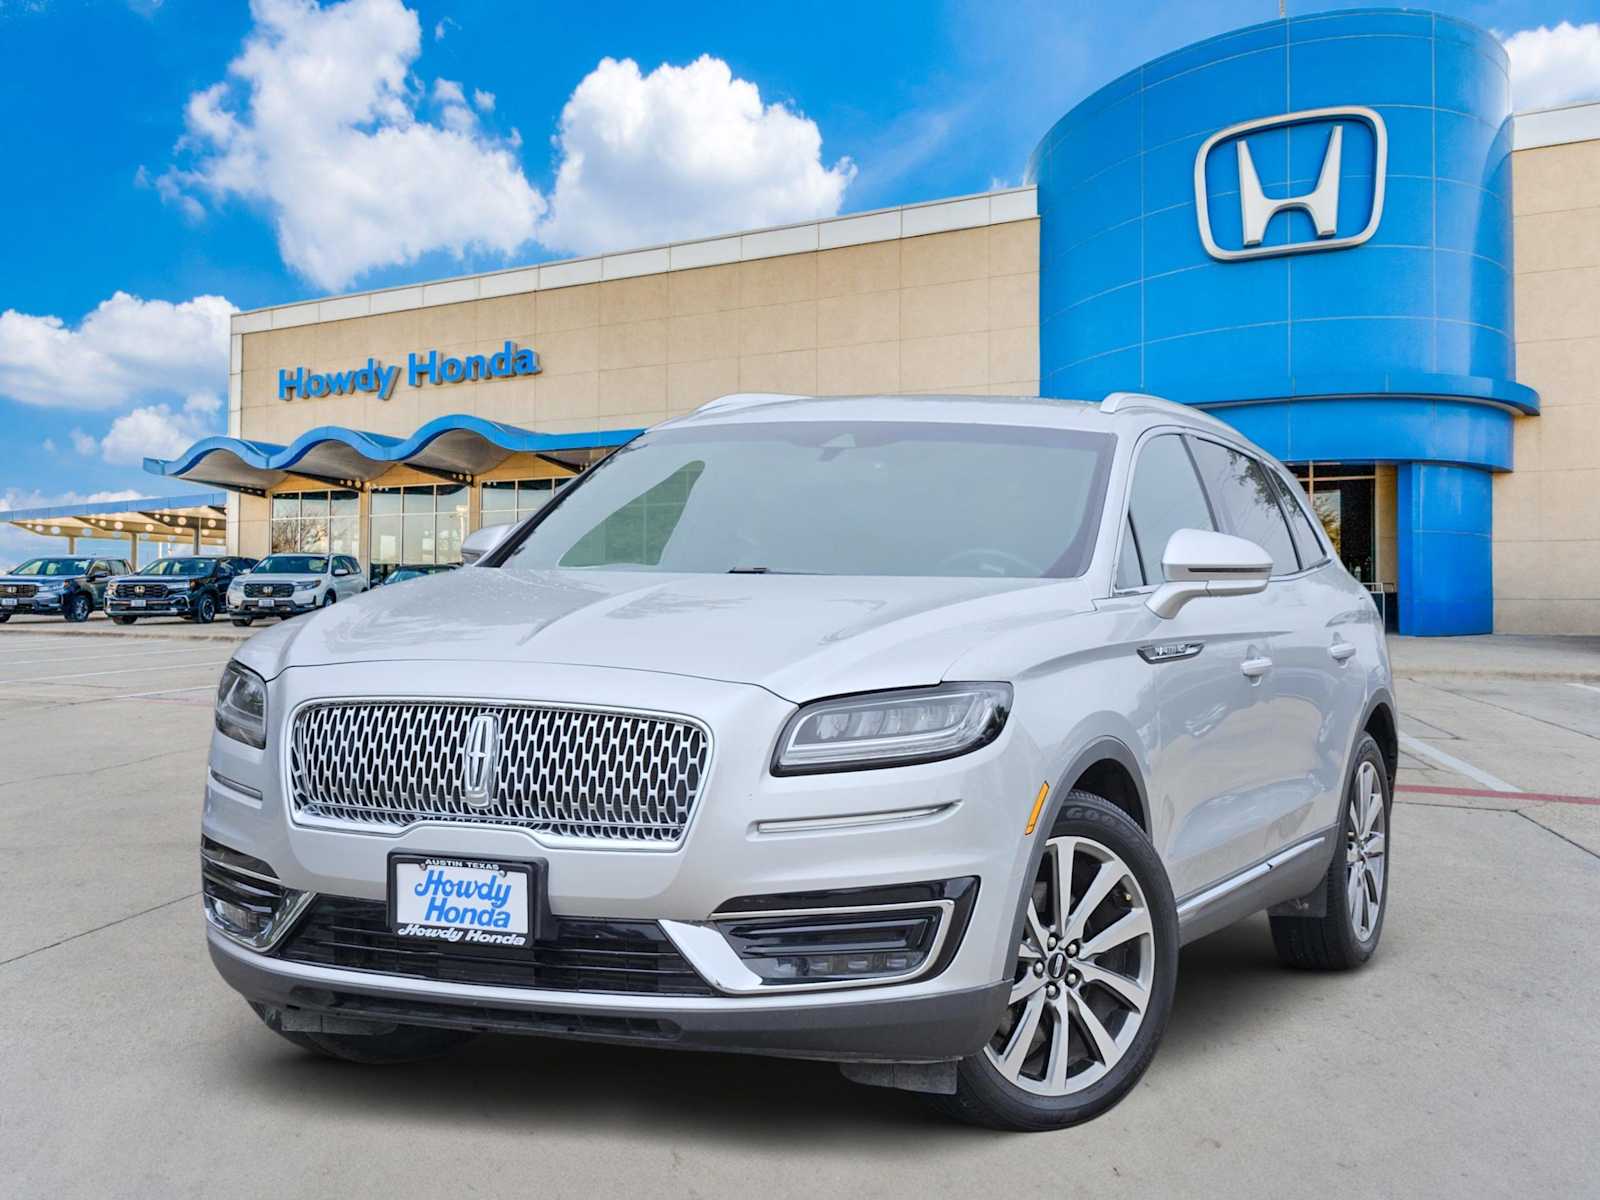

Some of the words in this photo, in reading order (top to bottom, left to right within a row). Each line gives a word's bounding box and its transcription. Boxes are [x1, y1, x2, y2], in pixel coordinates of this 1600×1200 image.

[278, 357, 401, 401] Howdy
[408, 340, 542, 388] Honda
[425, 859, 463, 868] AUSTIN
[467, 862, 500, 870] TEXAS
[415, 870, 512, 908] Howdy
[425, 897, 511, 928] Honda
[398, 923, 464, 942] Howdy
[465, 931, 526, 946] Honda
